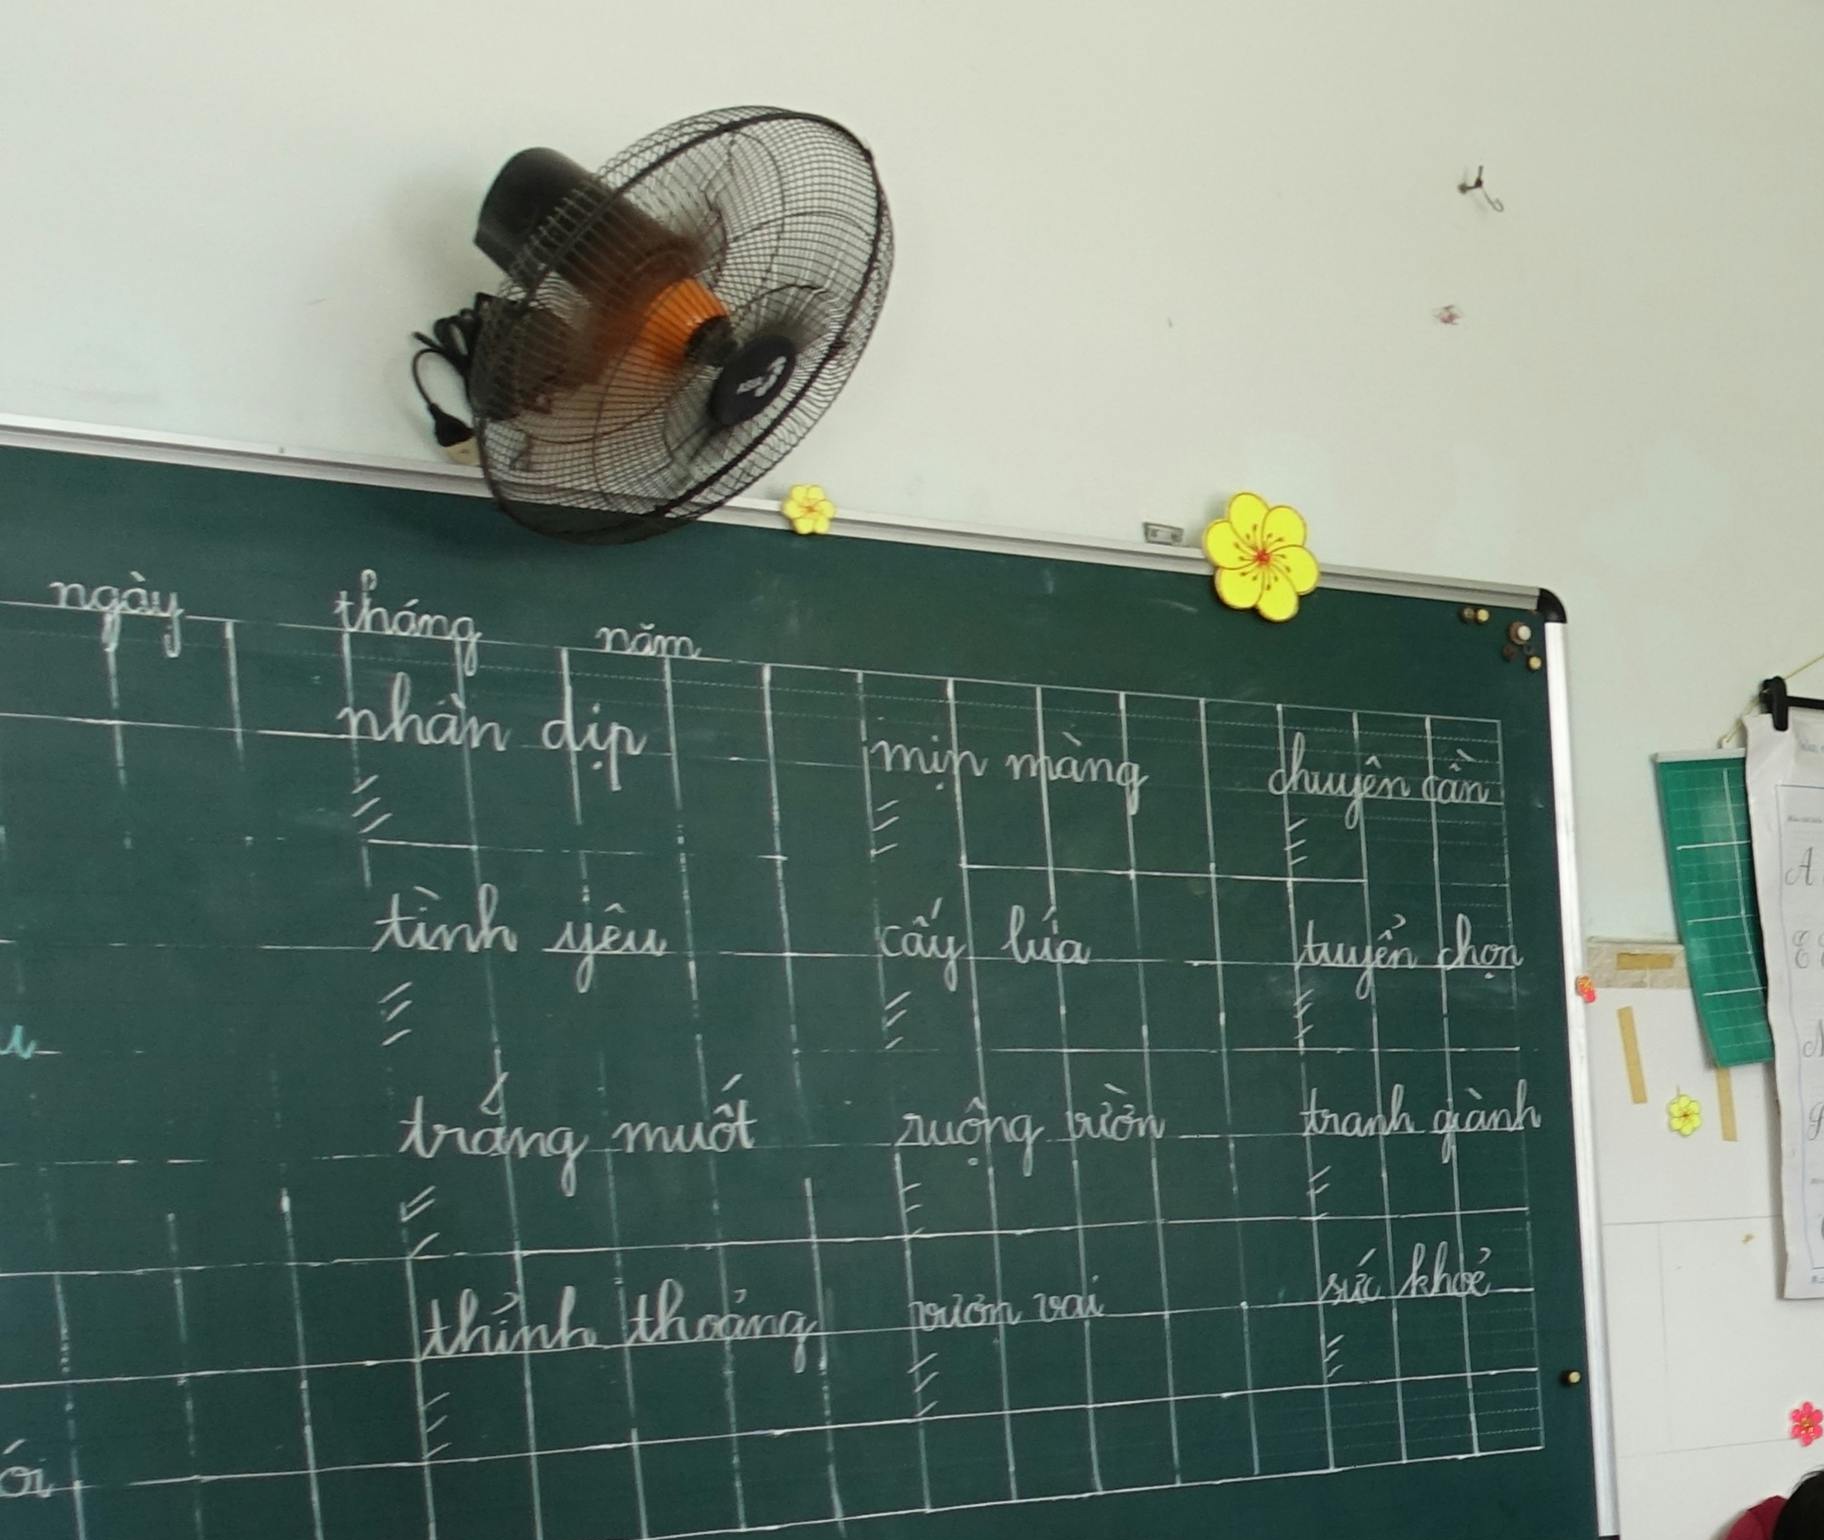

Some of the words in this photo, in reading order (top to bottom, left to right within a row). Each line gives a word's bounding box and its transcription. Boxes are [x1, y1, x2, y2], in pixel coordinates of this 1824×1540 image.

[49, 570, 185, 658] ngày
[334, 569, 483, 676] tháng
[595, 622, 702, 658] năm
[542, 688, 647, 791] dịp
[871, 734, 988, 790] mịn
[1005, 731, 1149, 815] màng
[1268, 732, 1411, 829] chuyên
[1422, 748, 1490, 803] cần
[1785, 847, 1814, 886] A
[372, 884, 517, 953] tình
[552, 902, 667, 993] yêu
[880, 898, 965, 992] cấy
[1001, 904, 1091, 964] lúa
[1300, 914, 1418, 1000] tuyển
[1438, 913, 1523, 979] chọn
[399, 1072, 589, 1197] trắng
[612, 1073, 757, 1153] muốt
[895, 1097, 1045, 1176] ruộng
[1066, 1083, 1166, 1141] vườn
[1300, 1084, 1416, 1137] tranh
[1433, 1079, 1541, 1164] giành
[908, 1294, 1022, 1331] vươn
[1033, 1275, 1104, 1322] vai
[1321, 1248, 1382, 1305] sức
[422, 1288, 597, 1359] thỉnh
[628, 1278, 818, 1373] thoảng
